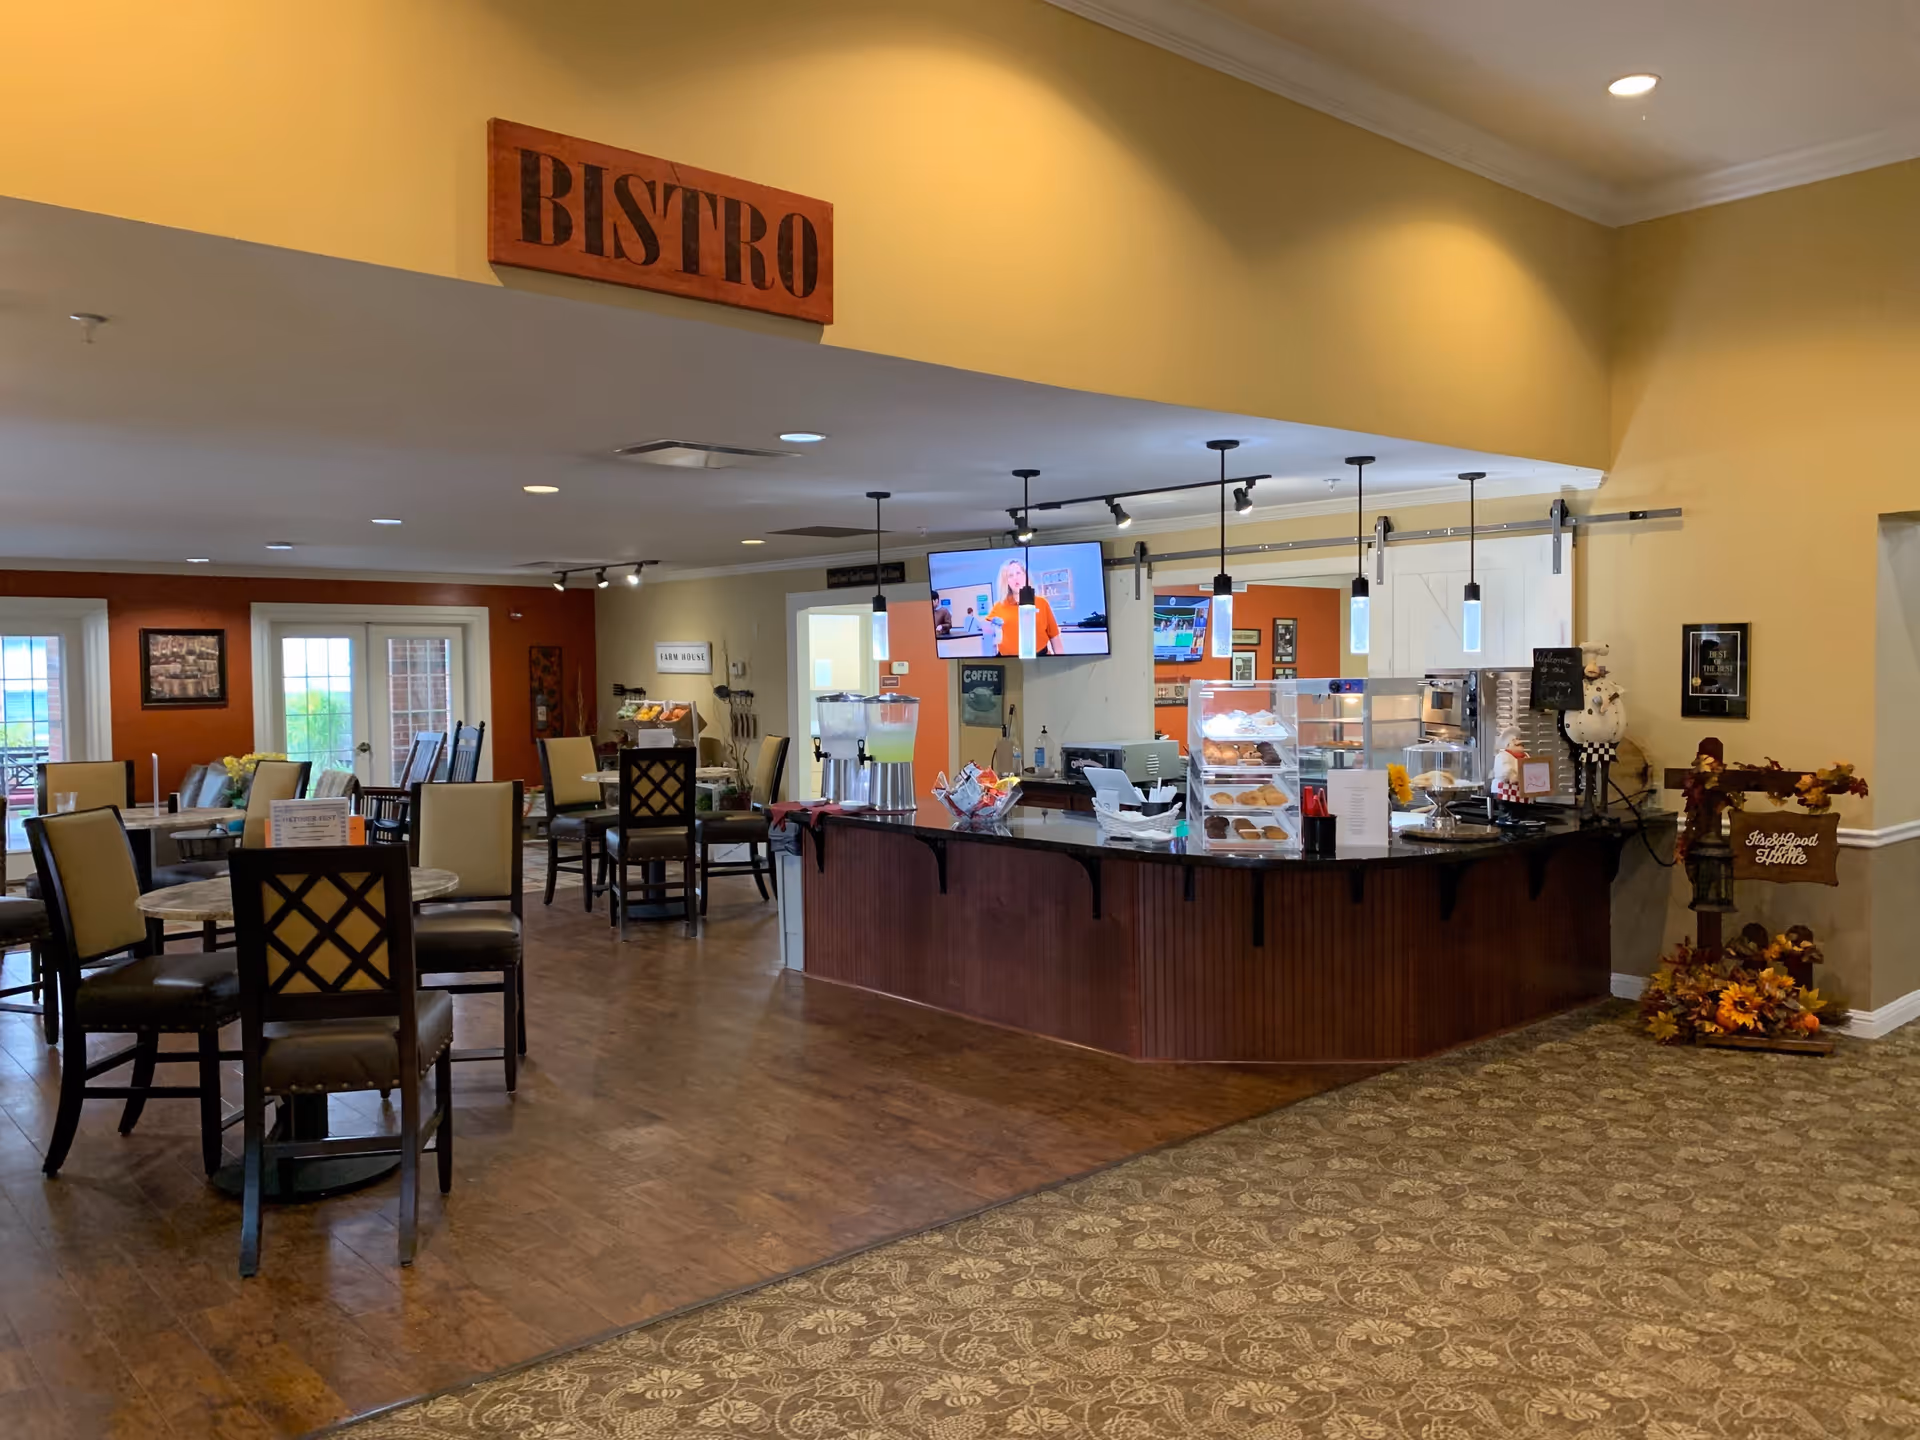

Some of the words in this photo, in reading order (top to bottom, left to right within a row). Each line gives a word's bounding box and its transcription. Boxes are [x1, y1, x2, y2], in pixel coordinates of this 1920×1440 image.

[514, 147, 819, 299] BISTRO
[660, 652, 679, 661] FARM
[681, 652, 706, 661] HOUSE
[1535, 651, 1572, 665] Welcome
[1708, 650, 1728, 659] BEST
[963, 669, 999, 683] COFFEE
[1703, 665, 1716, 673] THE
[1717, 665, 1733, 673] BEST
[1783, 832, 1819, 847] Good
[1755, 848, 1808, 866] Home
